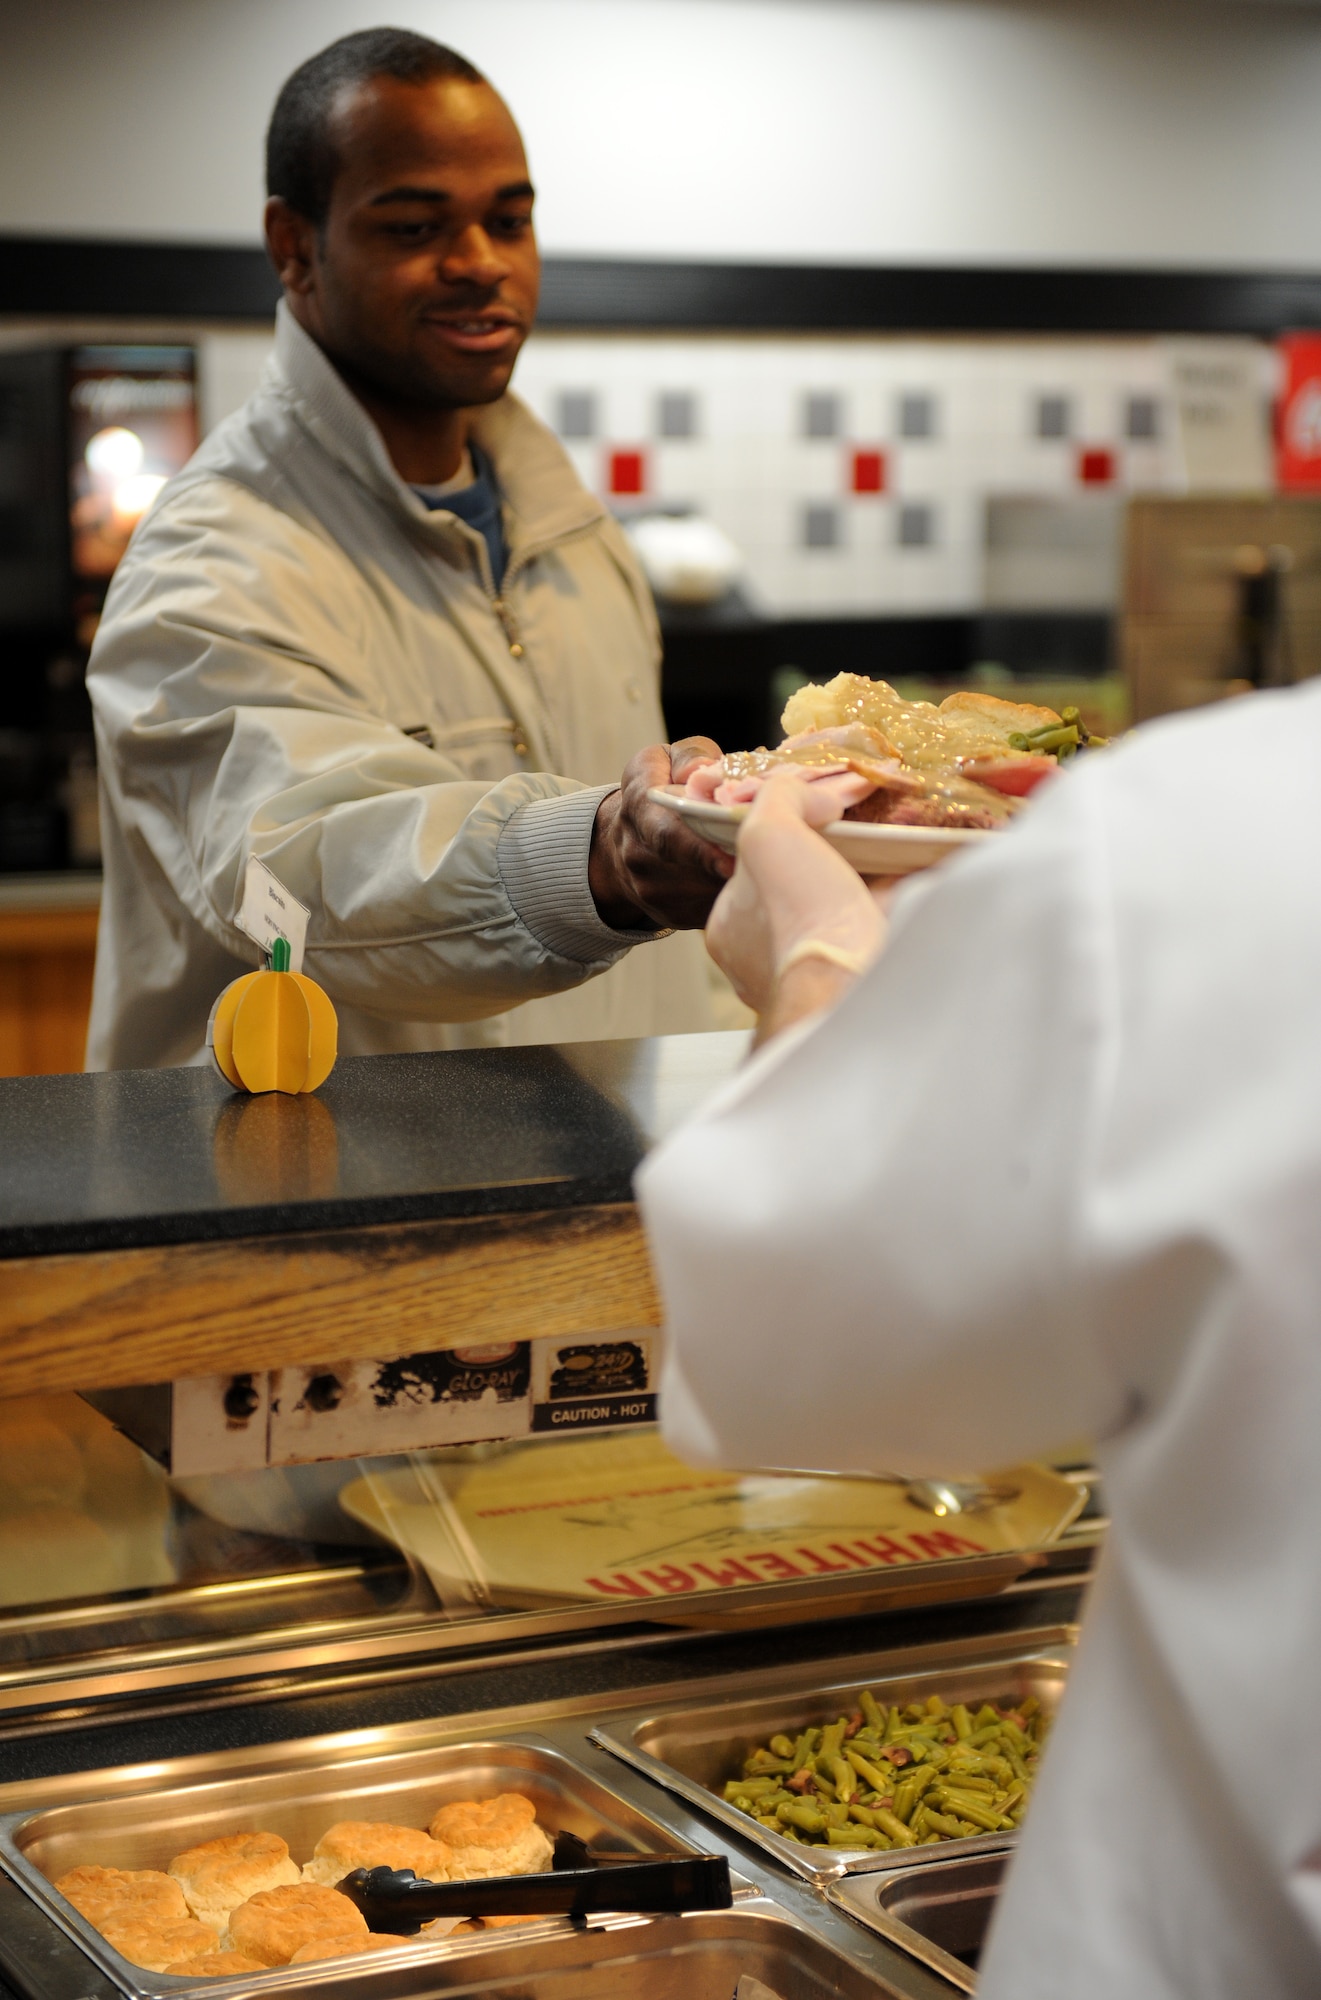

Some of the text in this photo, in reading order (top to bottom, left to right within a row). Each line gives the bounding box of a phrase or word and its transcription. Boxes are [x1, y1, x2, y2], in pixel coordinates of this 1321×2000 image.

[551, 1406, 610, 1424] CAUTION
[620, 1402, 648, 1417] HOT
[584, 1529, 990, 1597] WHITEMAN
